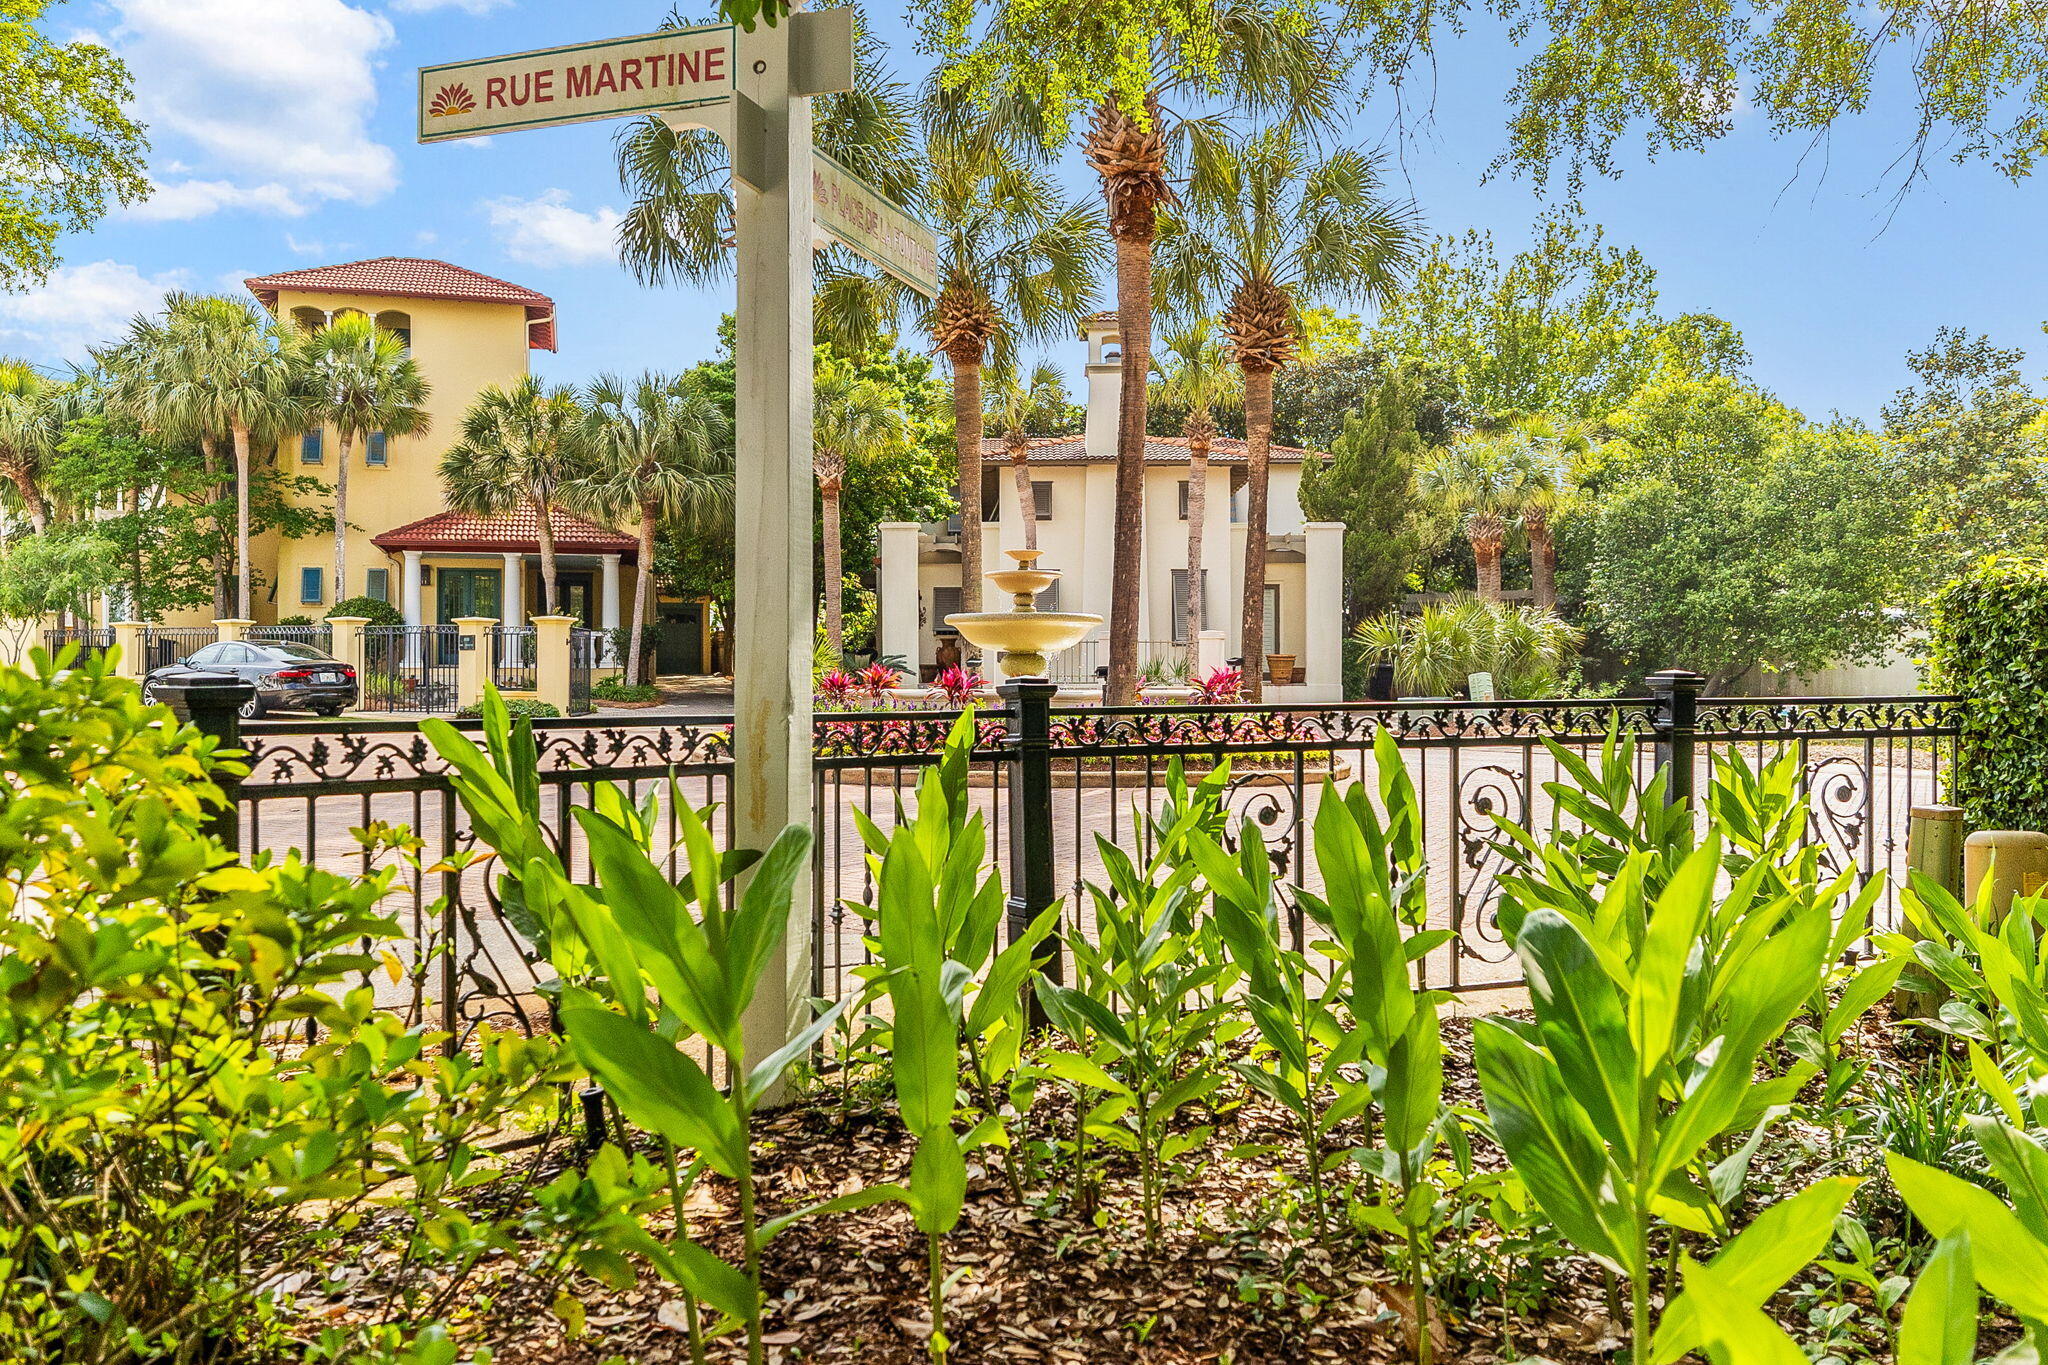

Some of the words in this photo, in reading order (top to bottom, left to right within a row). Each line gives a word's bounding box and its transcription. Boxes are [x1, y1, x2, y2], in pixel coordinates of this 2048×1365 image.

[486, 69, 554, 109] RUE
[566, 47, 725, 99] MARTINE
[831, 182, 864, 230] PLACE
[865, 206, 879, 240] DE
[880, 217, 892, 249] LA
